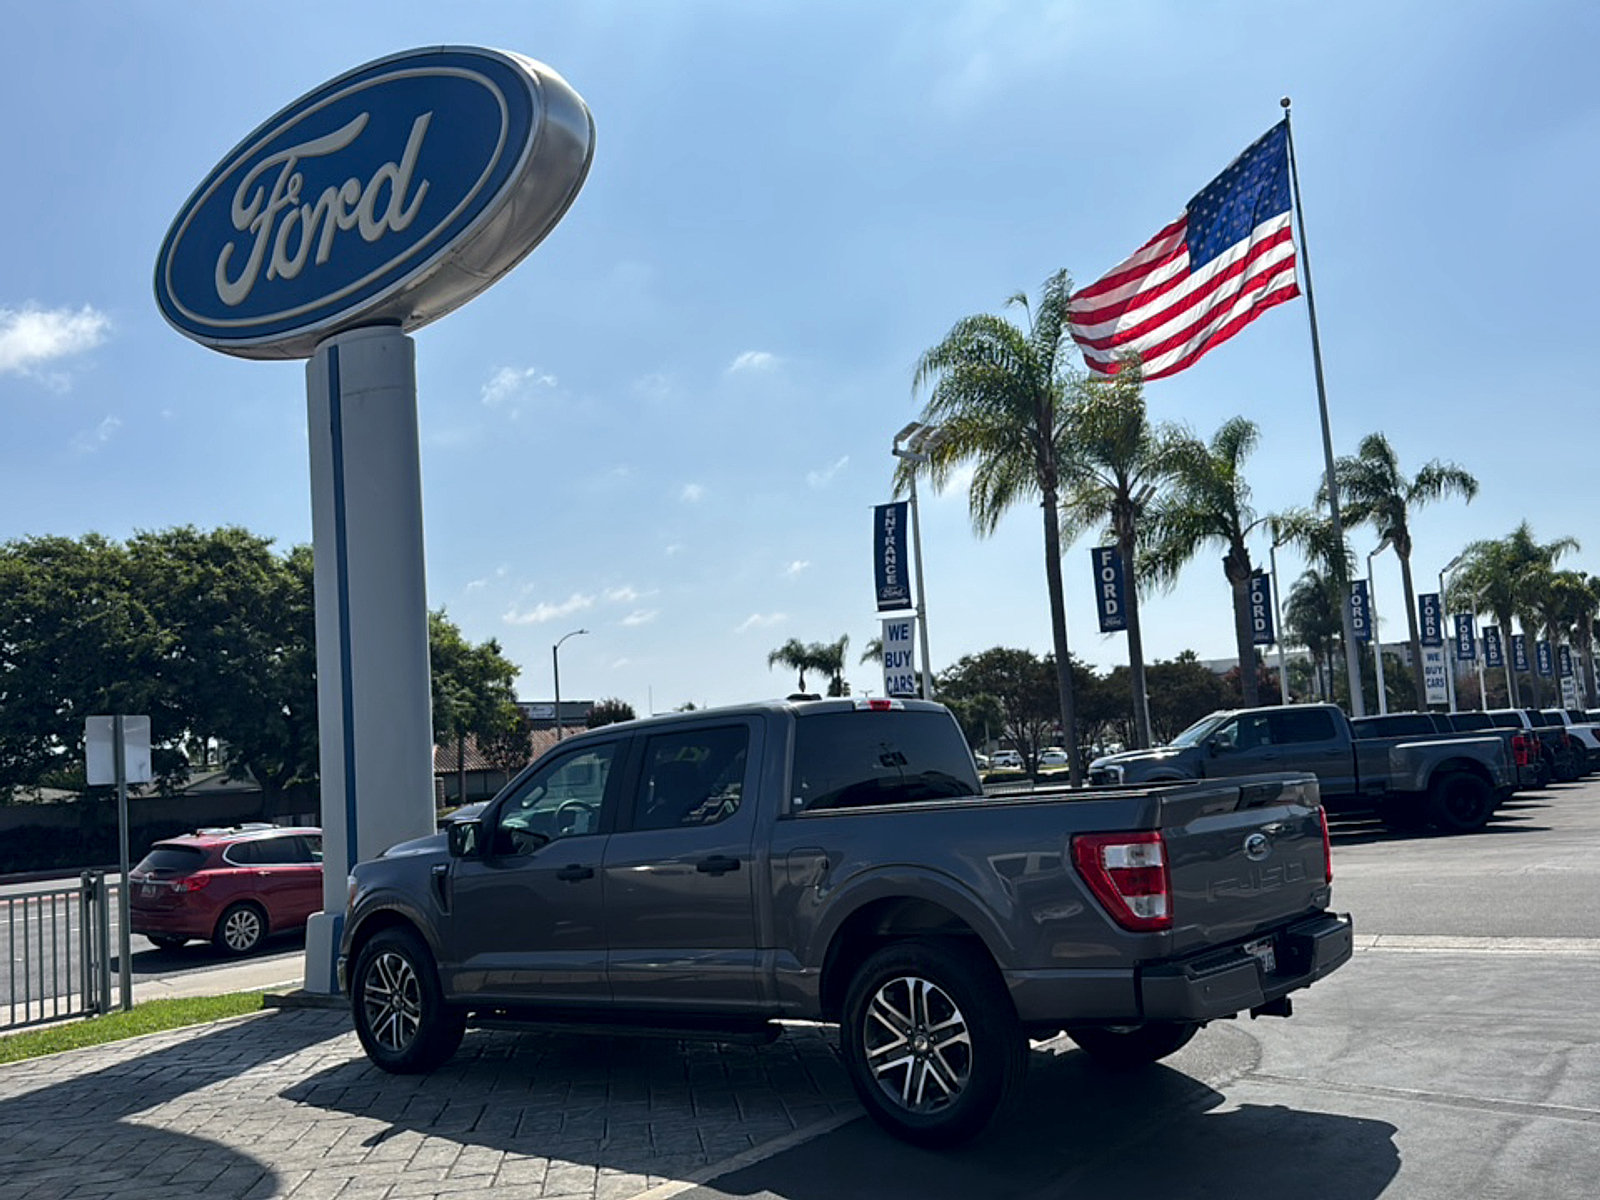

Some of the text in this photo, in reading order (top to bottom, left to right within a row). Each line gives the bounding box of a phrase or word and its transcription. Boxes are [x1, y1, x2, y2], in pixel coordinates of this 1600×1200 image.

[214, 110, 433, 307] Ford
[885, 507, 896, 584] ENTRANCE
[1101, 551, 1118, 615] FORD
[1252, 578, 1266, 631] FORD
[1351, 583, 1364, 628] FORD
[1424, 597, 1435, 635] FORD
[888, 624, 909, 641] WE
[1459, 616, 1470, 651] FORD
[1487, 629, 1498, 659] FORD
[885, 650, 912, 668] BUY
[1427, 653, 1440, 661] WE
[1516, 637, 1525, 664] FORD
[887, 675, 914, 695] CARS
[1425, 666, 1442, 674] BUY
[1427, 678, 1444, 688] CARS
